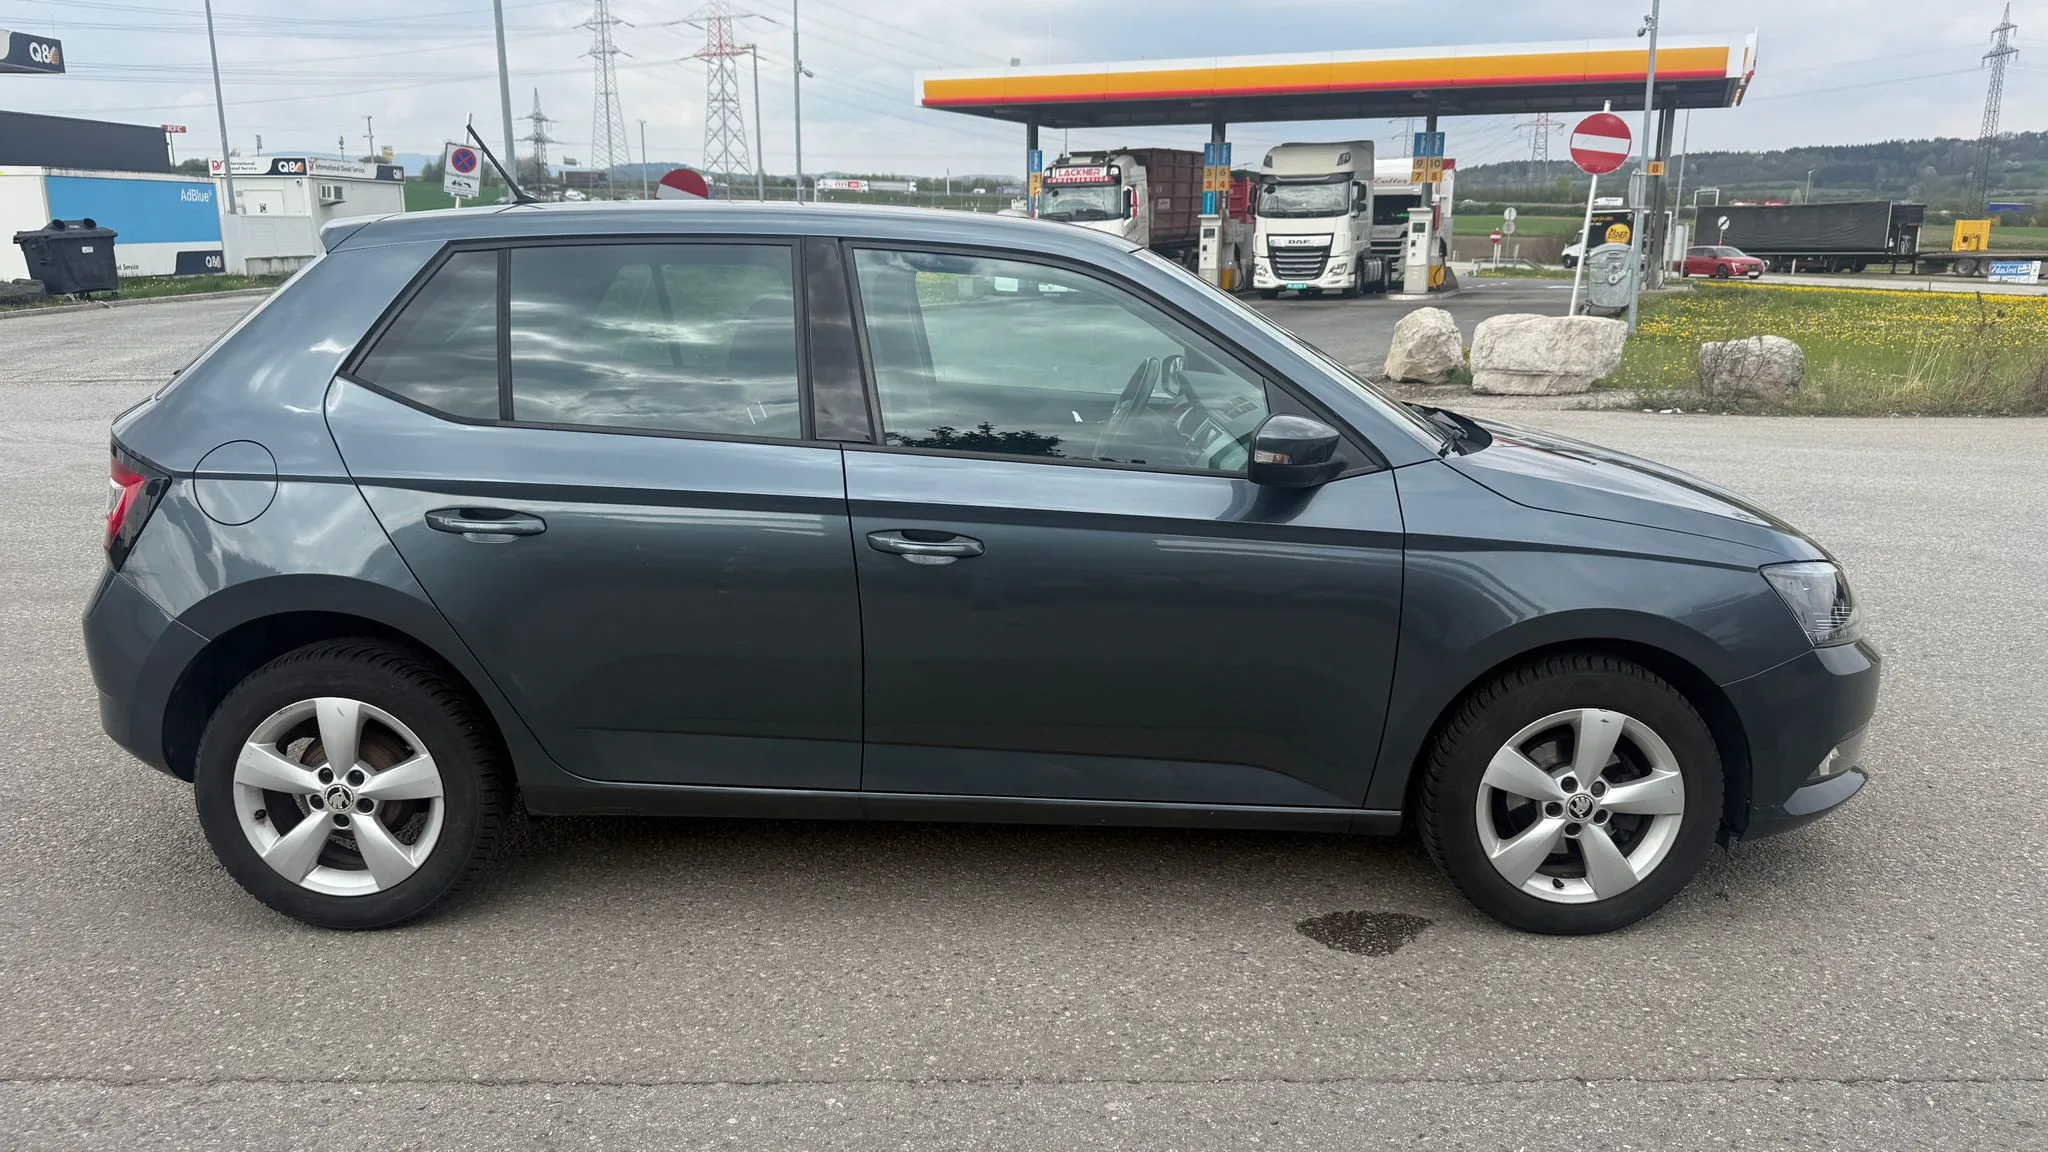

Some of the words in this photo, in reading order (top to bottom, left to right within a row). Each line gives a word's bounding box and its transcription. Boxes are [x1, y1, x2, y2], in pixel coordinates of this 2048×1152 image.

[29, 41, 52, 63] Q8
[278, 161, 297, 173] Q8
[1430, 160, 1441, 168] 10
[1652, 163, 1659, 173] 8
[1058, 168, 1101, 177] LACKNER
[1431, 172, 1438, 181] 8
[205, 256, 217, 268] Q8
